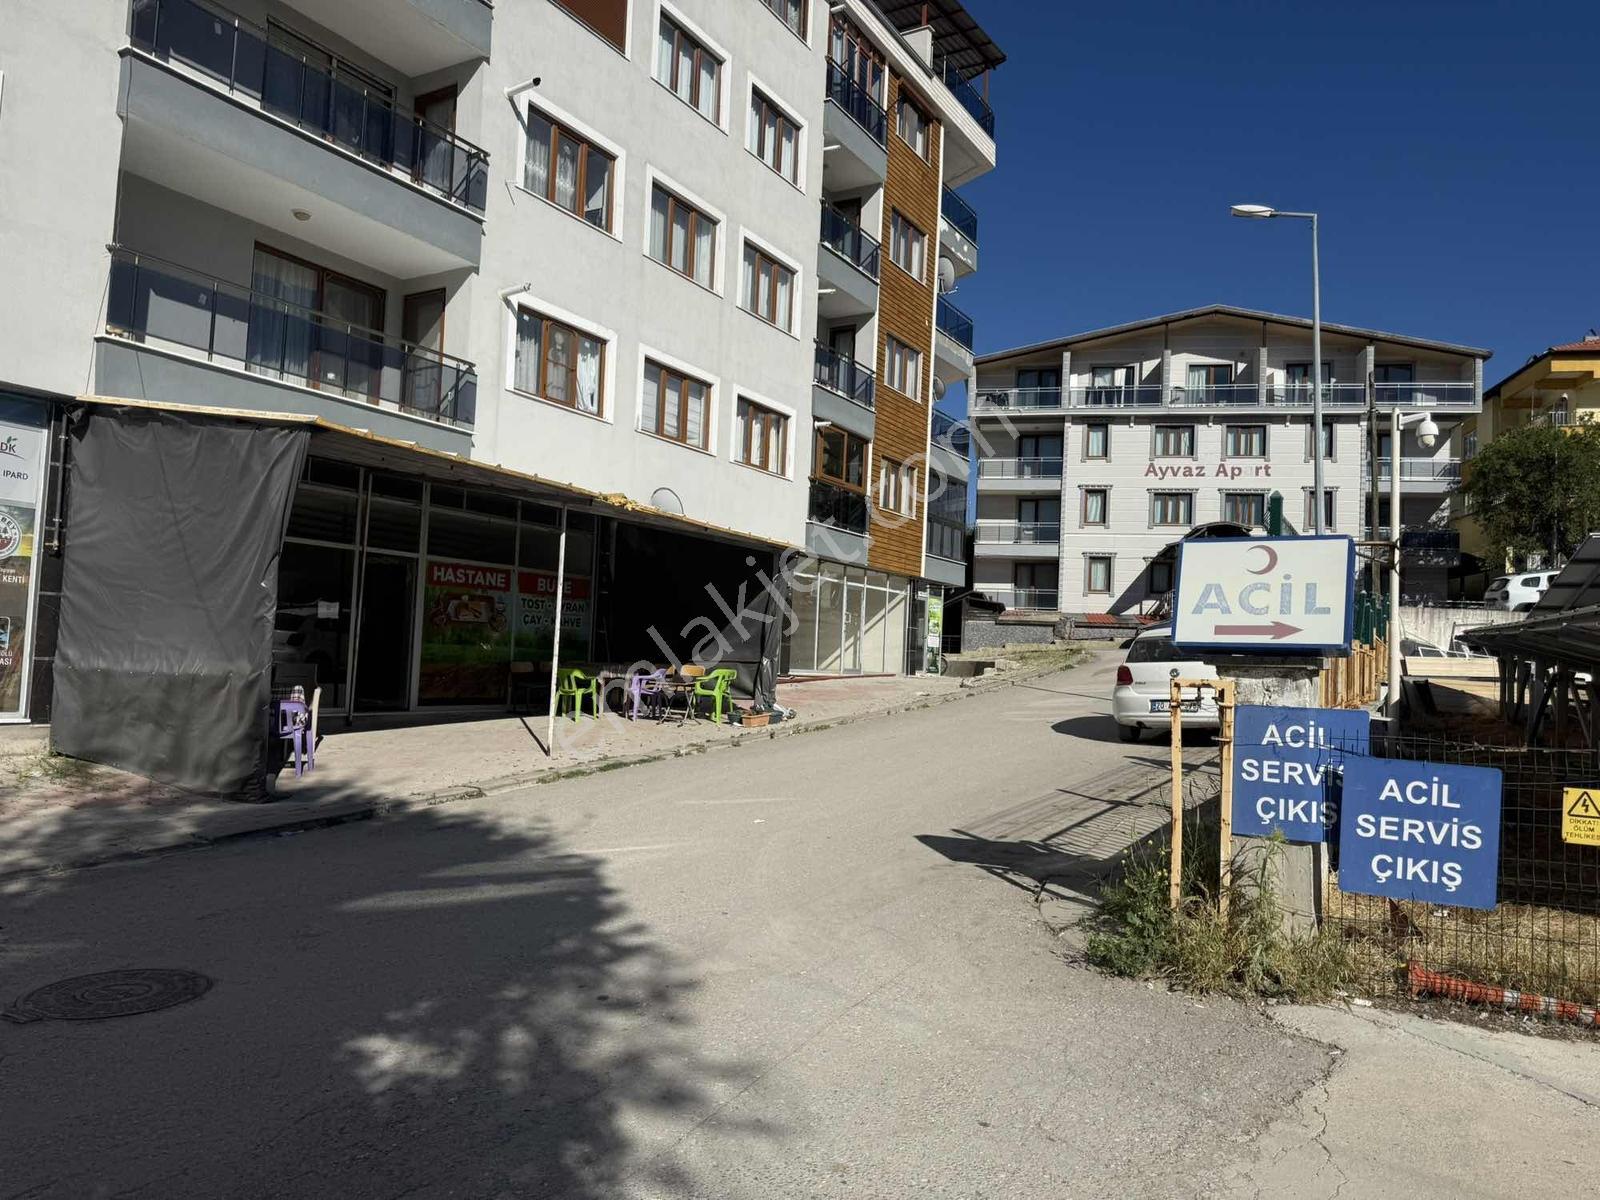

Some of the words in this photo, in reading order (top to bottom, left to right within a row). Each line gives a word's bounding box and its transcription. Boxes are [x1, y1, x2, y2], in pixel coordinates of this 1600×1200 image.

[3, 470, 29, 480] IPARD
[1144, 462, 1206, 481] Ayvaz
[1215, 463, 1271, 481] Aprt
[432, 565, 506, 588] HASTANE
[521, 597, 546, 610] TOST
[1191, 573, 1331, 616] ACİL
[1261, 720, 1335, 749] ACİL
[1379, 776, 1461, 809] ACİL
[1256, 797, 1338, 830] ÇIKIŞ
[1356, 814, 1483, 850] SERVİS
[1371, 854, 1463, 892] ÇIKIŞ
